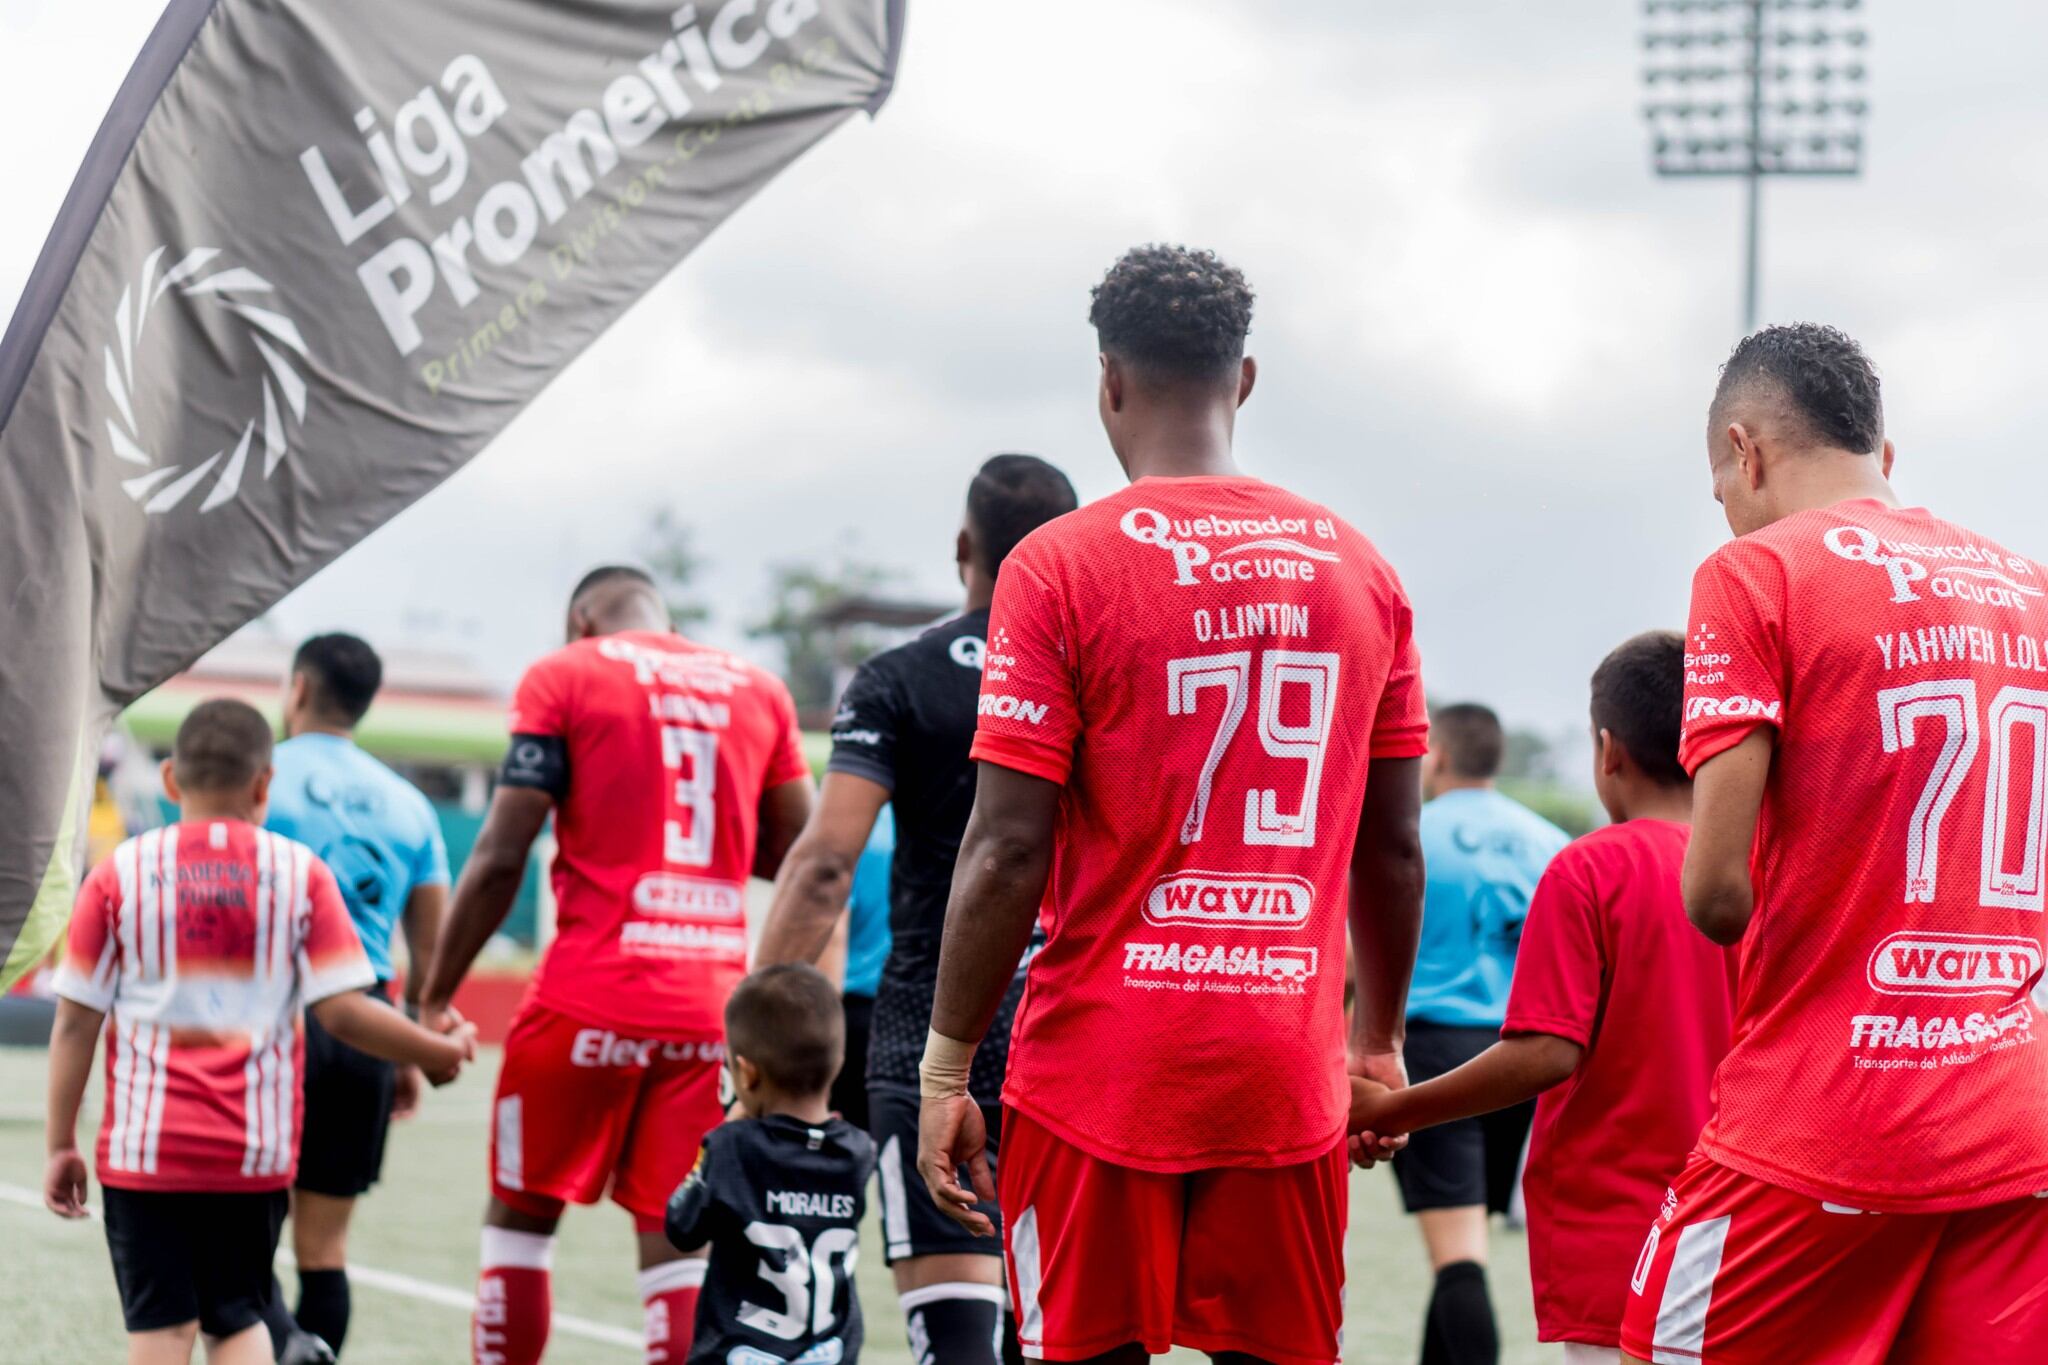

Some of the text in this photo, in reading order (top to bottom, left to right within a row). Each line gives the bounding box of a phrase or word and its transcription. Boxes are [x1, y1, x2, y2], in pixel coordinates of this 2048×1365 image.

[300, 54, 508, 245] Liga
[355, 0, 820, 356] Promerica
[421, 280, 548, 397] Primera
[1120, 507, 1337, 549] Quebrador el
[1823, 526, 2033, 576] Quebrador el
[1173, 541, 1315, 586] Pacuare
[1889, 556, 2027, 611] Pacuare
[1194, 603, 1309, 642] O.LINTON
[1684, 653, 1731, 673] Grupo
[1875, 625, 2048, 672] YAHWEH LOL
[1167, 650, 1341, 848] 79
[661, 725, 719, 868] 3
[1877, 679, 2048, 913] 70
[1164, 884, 1296, 915] wavin
[1122, 942, 1260, 976] FRAGASA
[1891, 947, 2031, 982] wavin
[1183, 979, 1200, 992] del
[1920, 1056, 1938, 1069] del
[767, 1190, 855, 1218] MORALES
[735, 1221, 860, 1336] 30
